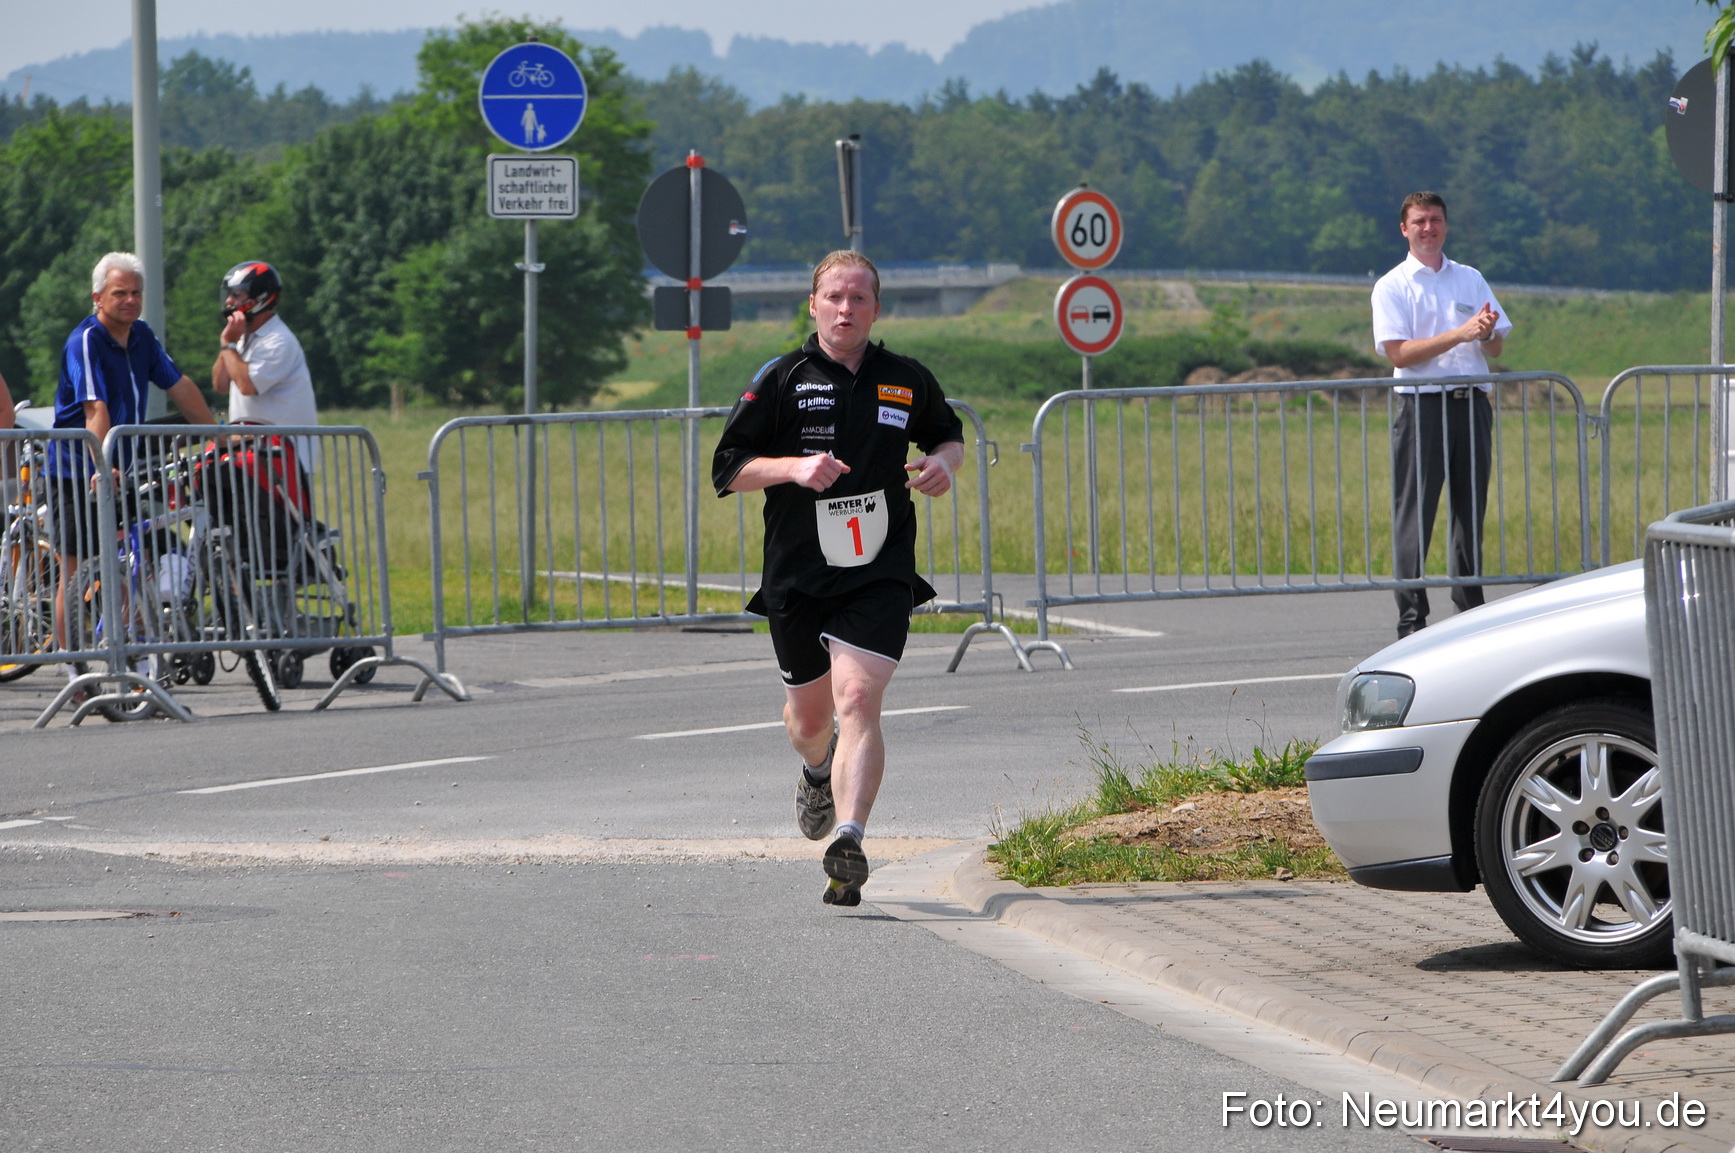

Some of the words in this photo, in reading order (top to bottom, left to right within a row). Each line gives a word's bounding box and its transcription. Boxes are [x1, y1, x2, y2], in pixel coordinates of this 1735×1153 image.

[504, 163, 562, 178] Landwirt-
[498, 180, 568, 194] schaftlicher
[498, 196, 544, 210] Verkehr
[547, 196, 570, 210] frei
[1071, 212, 1107, 248] 60
[801, 425, 835, 434] AMADEUS
[828, 498, 863, 511] MEYER
[828, 507, 864, 517] WERBUNG
[846, 516, 864, 557] 1
